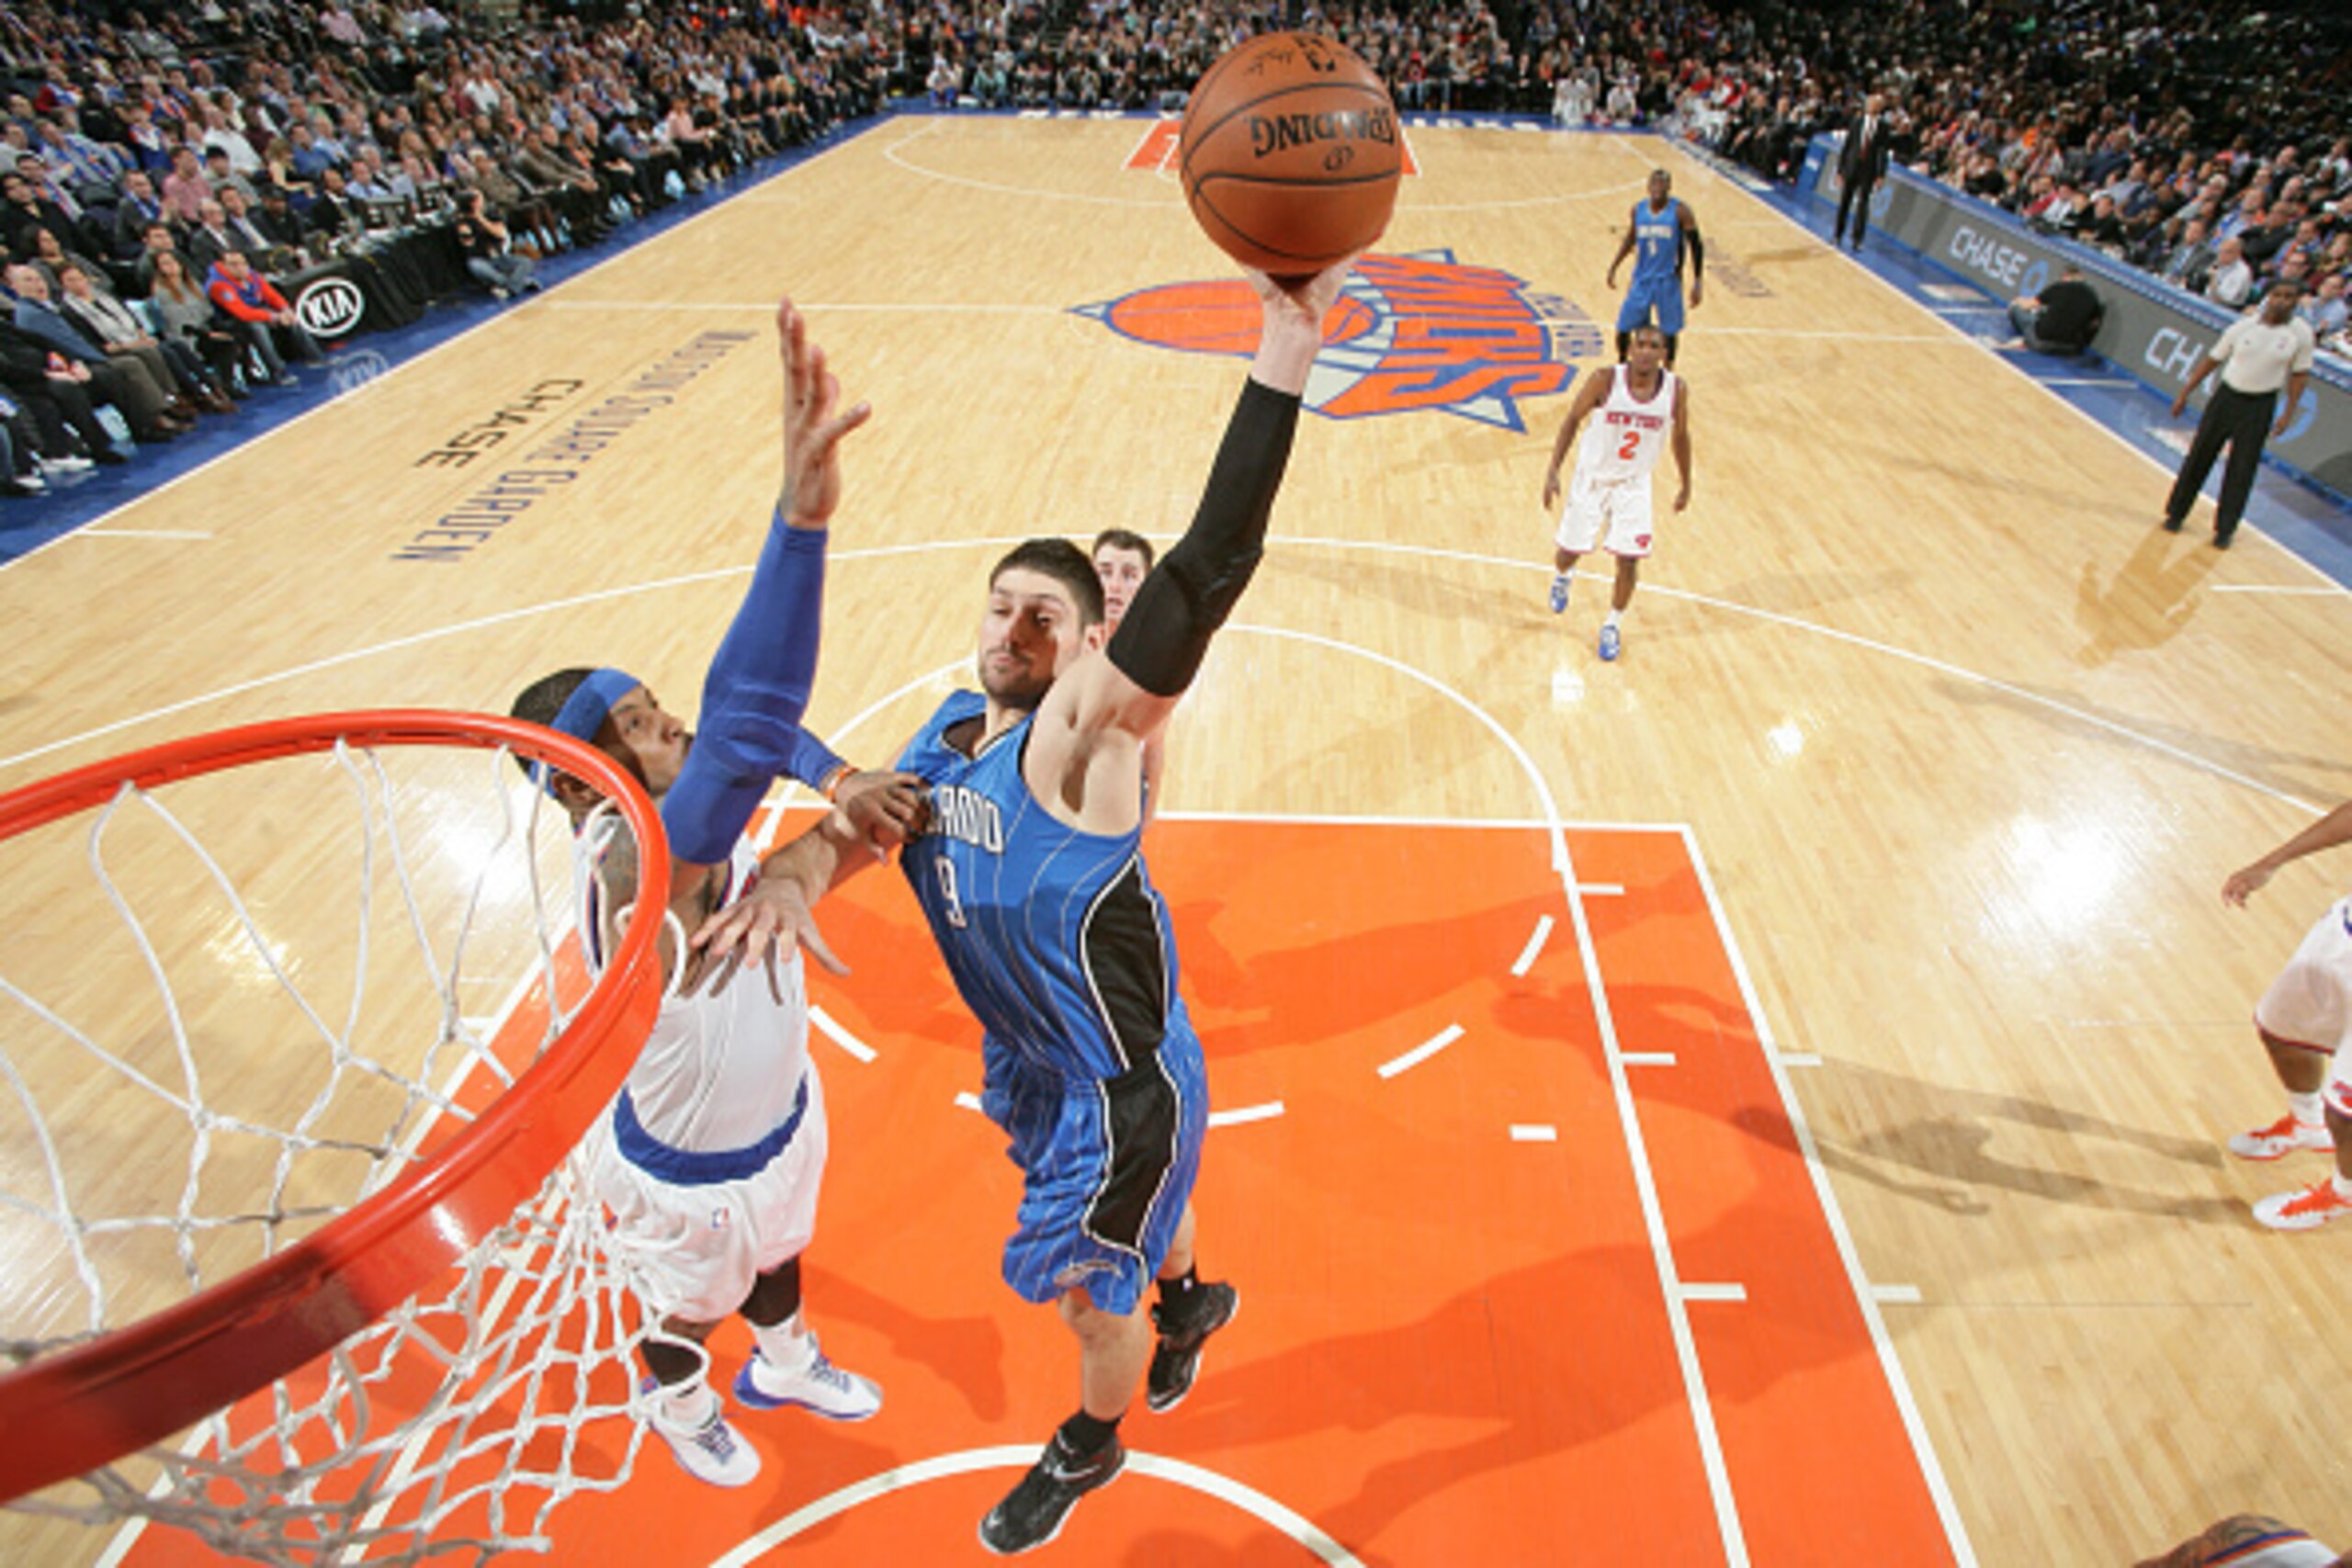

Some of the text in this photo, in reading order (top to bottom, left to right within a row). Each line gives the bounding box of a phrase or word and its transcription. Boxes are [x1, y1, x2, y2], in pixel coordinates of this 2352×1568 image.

[1949, 226, 2028, 287] CHASE
[305, 287, 356, 328] KIA
[1319, 251, 1577, 421] KNICKS
[413, 378, 585, 468] CHASE
[1618, 431, 1641, 460] 2
[389, 469, 579, 562] GARDEN
[933, 854, 967, 929] 9
